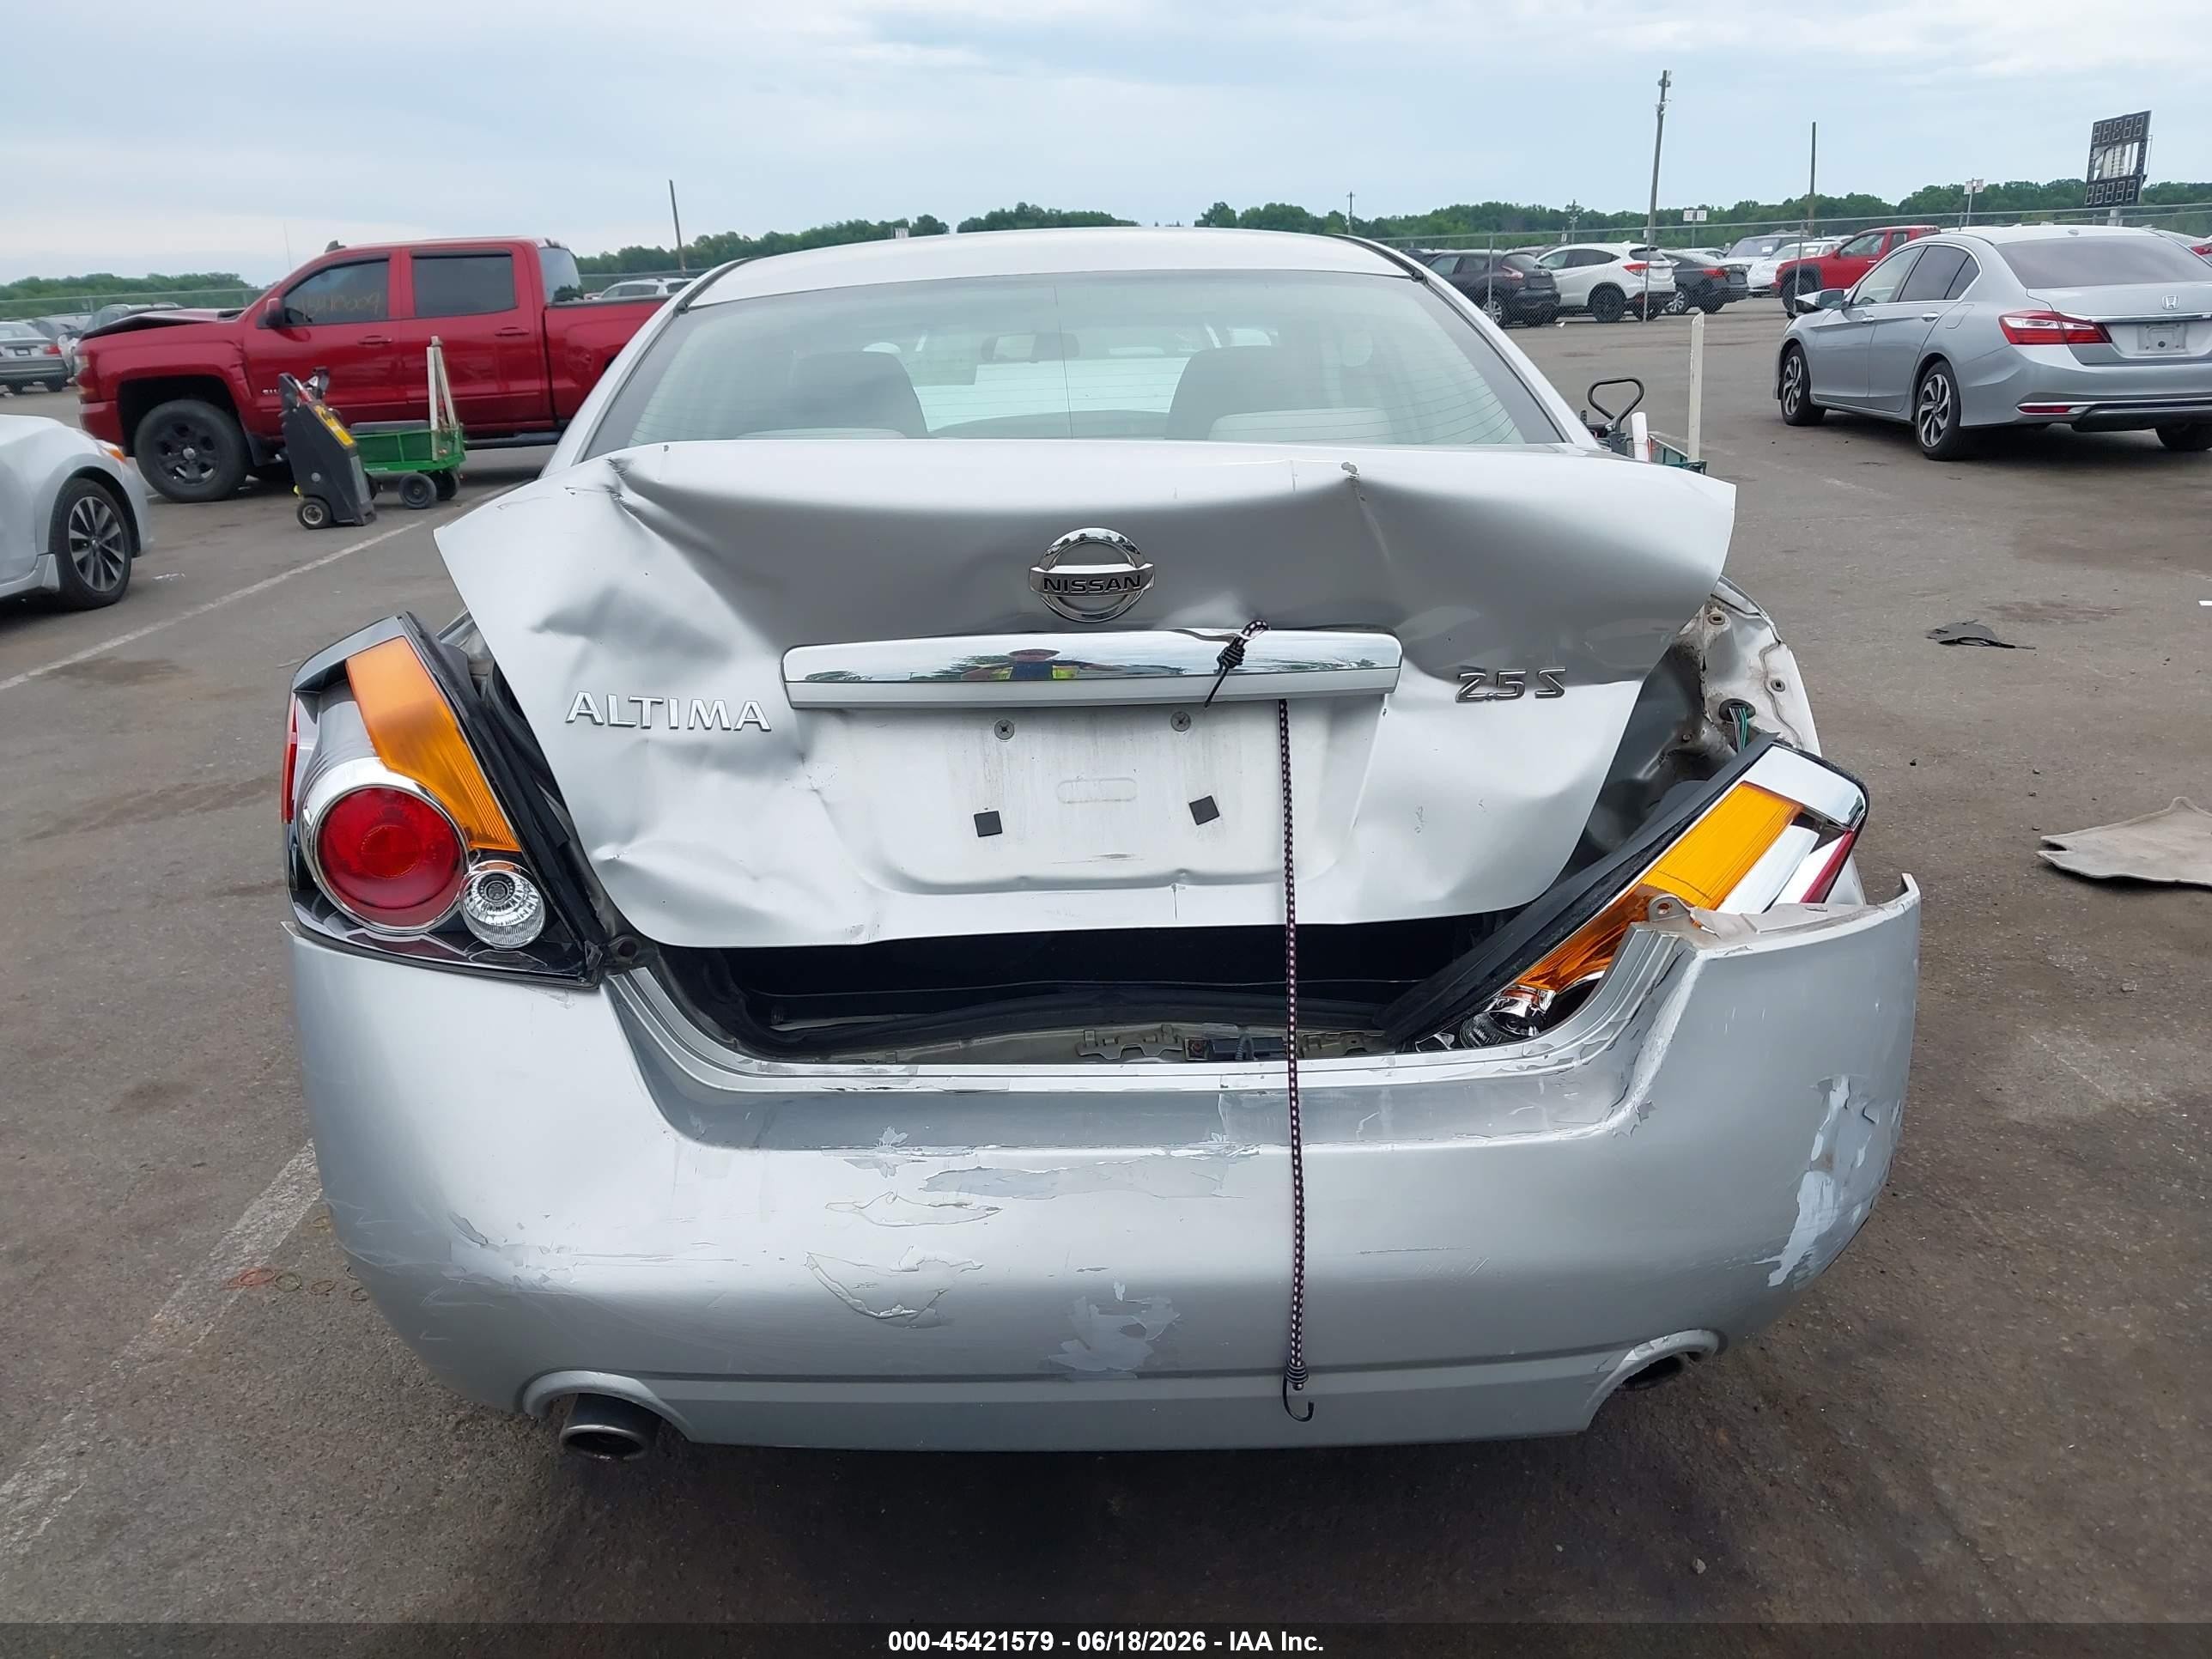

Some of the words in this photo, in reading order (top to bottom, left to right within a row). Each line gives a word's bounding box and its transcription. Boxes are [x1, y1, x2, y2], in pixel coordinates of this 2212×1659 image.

[1042, 574, 1141, 593] NISSAN
[1455, 670, 1527, 702] 2.5
[1534, 667, 1566, 699] S
[565, 690, 772, 732] ALTIMA
